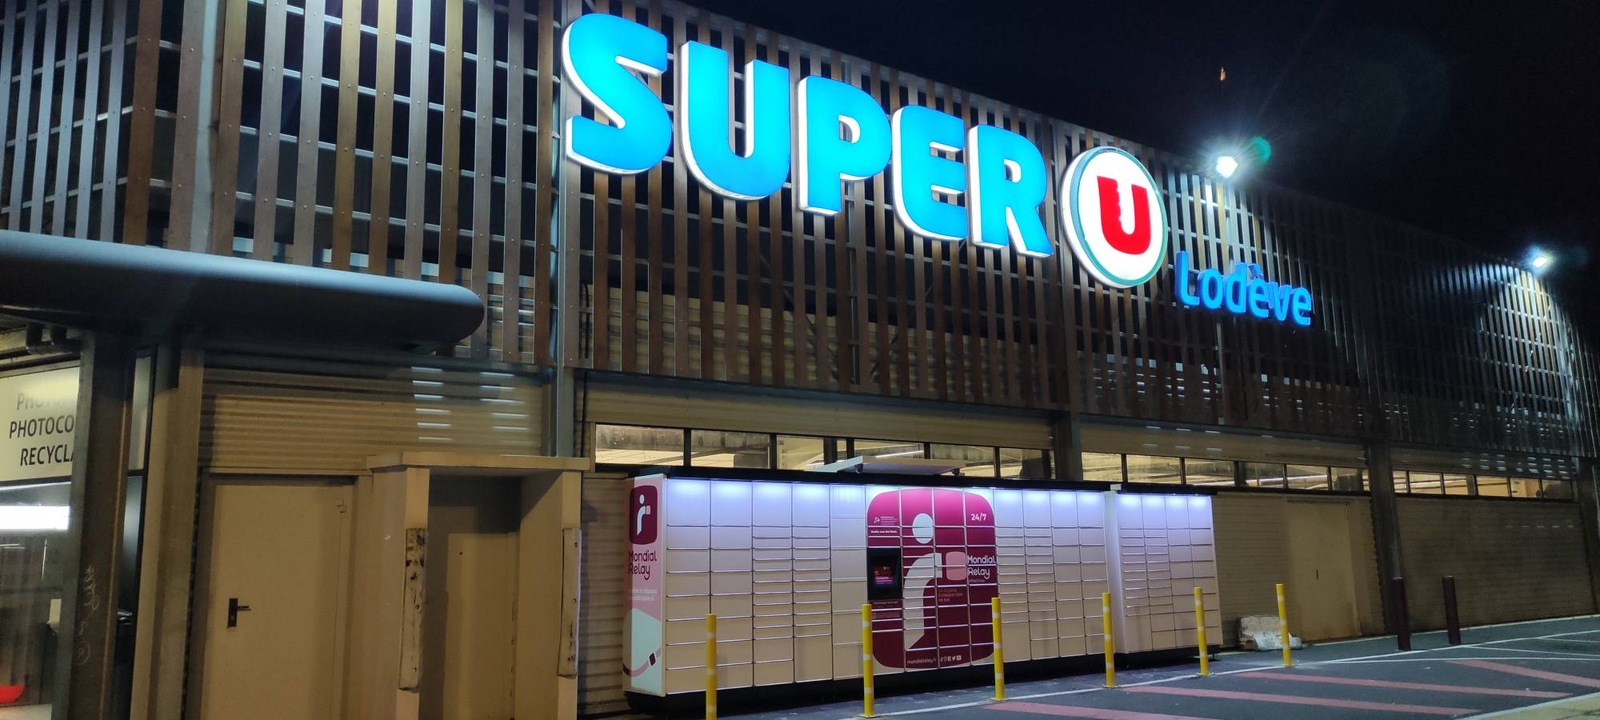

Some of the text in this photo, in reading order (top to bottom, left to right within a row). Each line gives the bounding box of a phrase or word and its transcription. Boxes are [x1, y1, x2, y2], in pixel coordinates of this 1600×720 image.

[562, 13, 1152, 258] SUPER U
[1174, 250, 1313, 327] Lodève
[970, 513, 987, 521] 24/7
[628, 550, 658, 562] Mondial
[967, 555, 996, 564] Mondial
[628, 563, 651, 580] Relay
[967, 567, 991, 579] Relay
